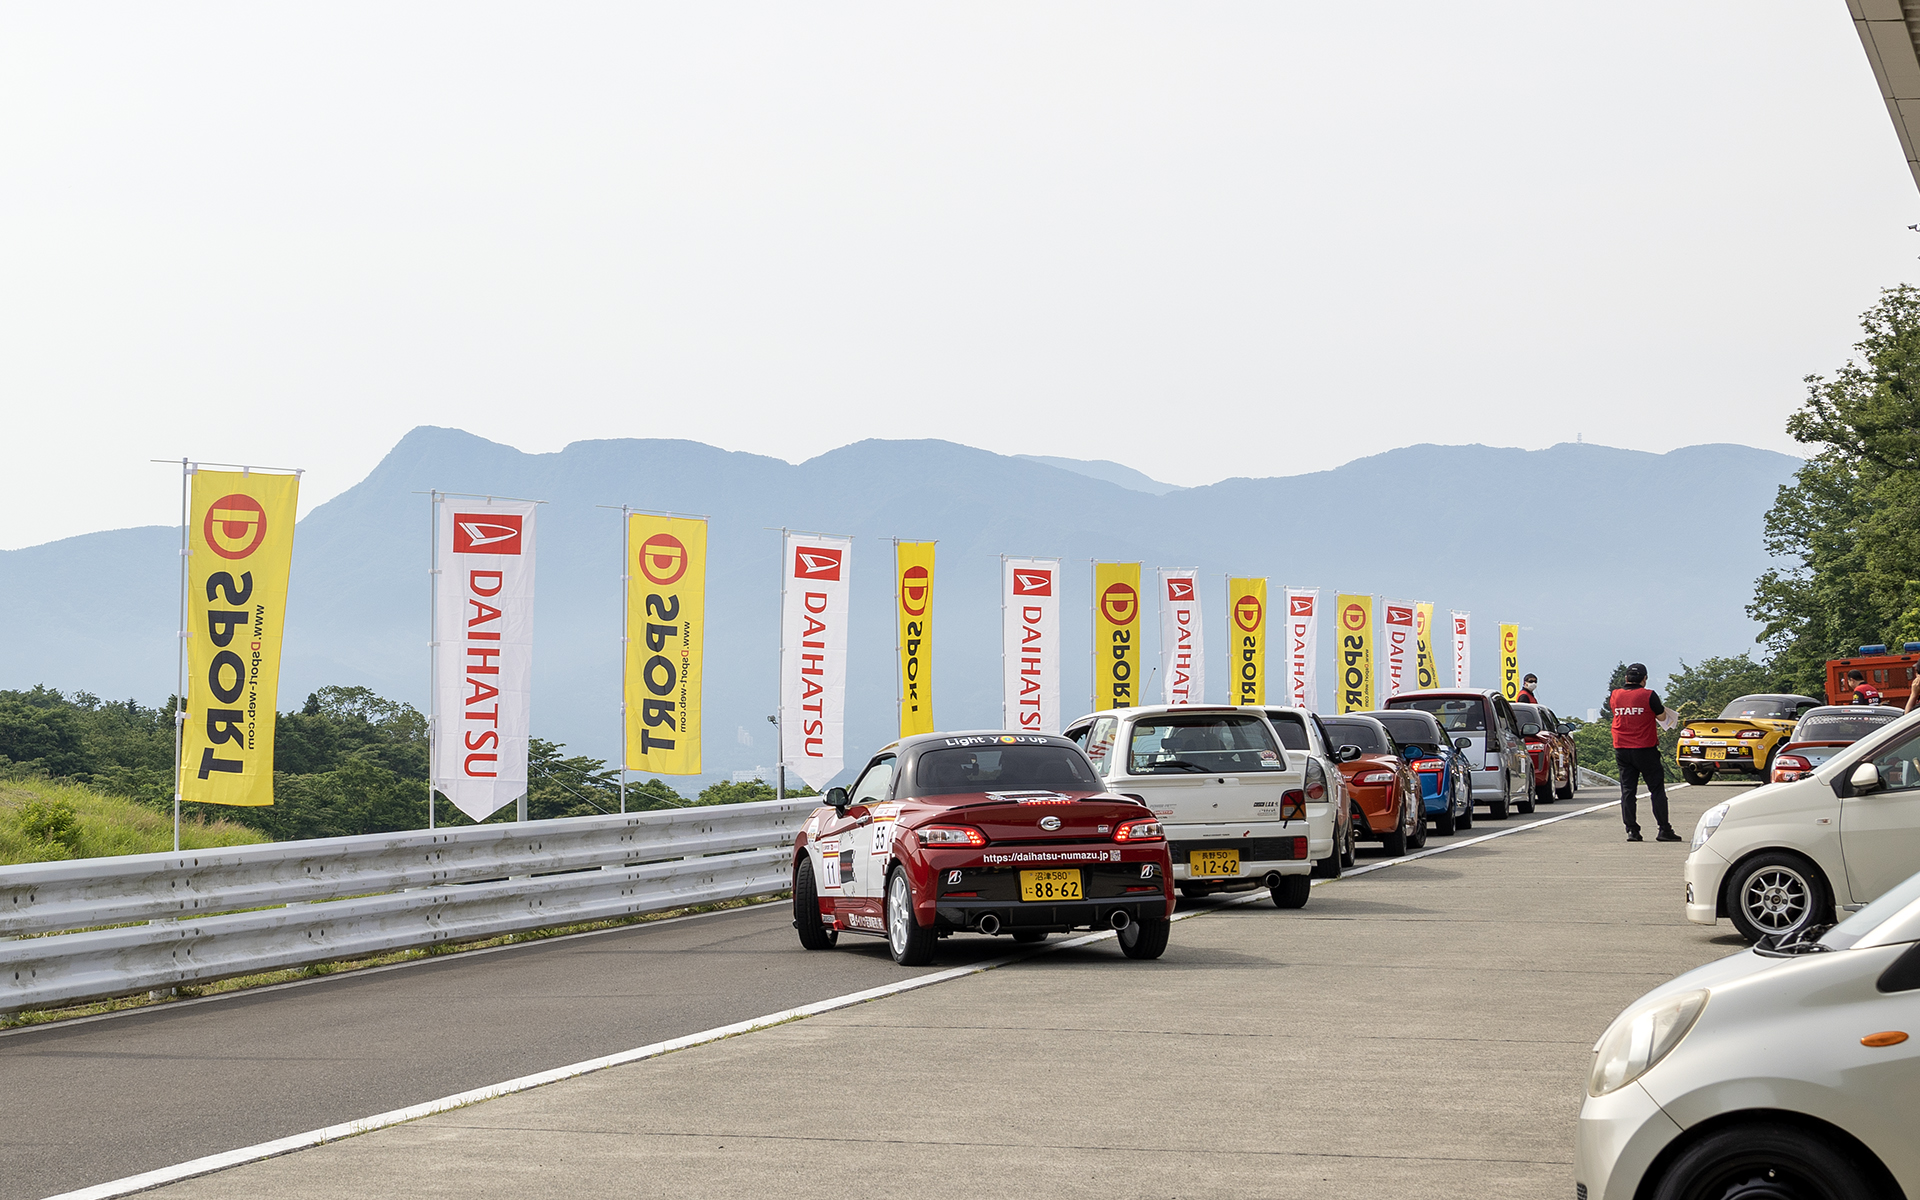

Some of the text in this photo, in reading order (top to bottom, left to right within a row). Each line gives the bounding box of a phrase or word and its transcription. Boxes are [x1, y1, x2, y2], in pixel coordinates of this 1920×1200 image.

[464, 570, 503, 778] DAIHATSU
[802, 591, 828, 758] DAIHATSU
[1019, 606, 1042, 732] DAIHATS
[1390, 631, 1406, 696] DAIHA
[1614, 707, 1644, 716] STAFF
[944, 736, 986, 746] Light
[1028, 736, 1048, 744] up
[875, 826, 886, 850] 55
[983, 850, 1109, 864] https://daihatsu-numazu.jp
[1202, 860, 1237, 874] 12-62
[826, 862, 836, 884] 11
[1035, 881, 1079, 898] 88-62
